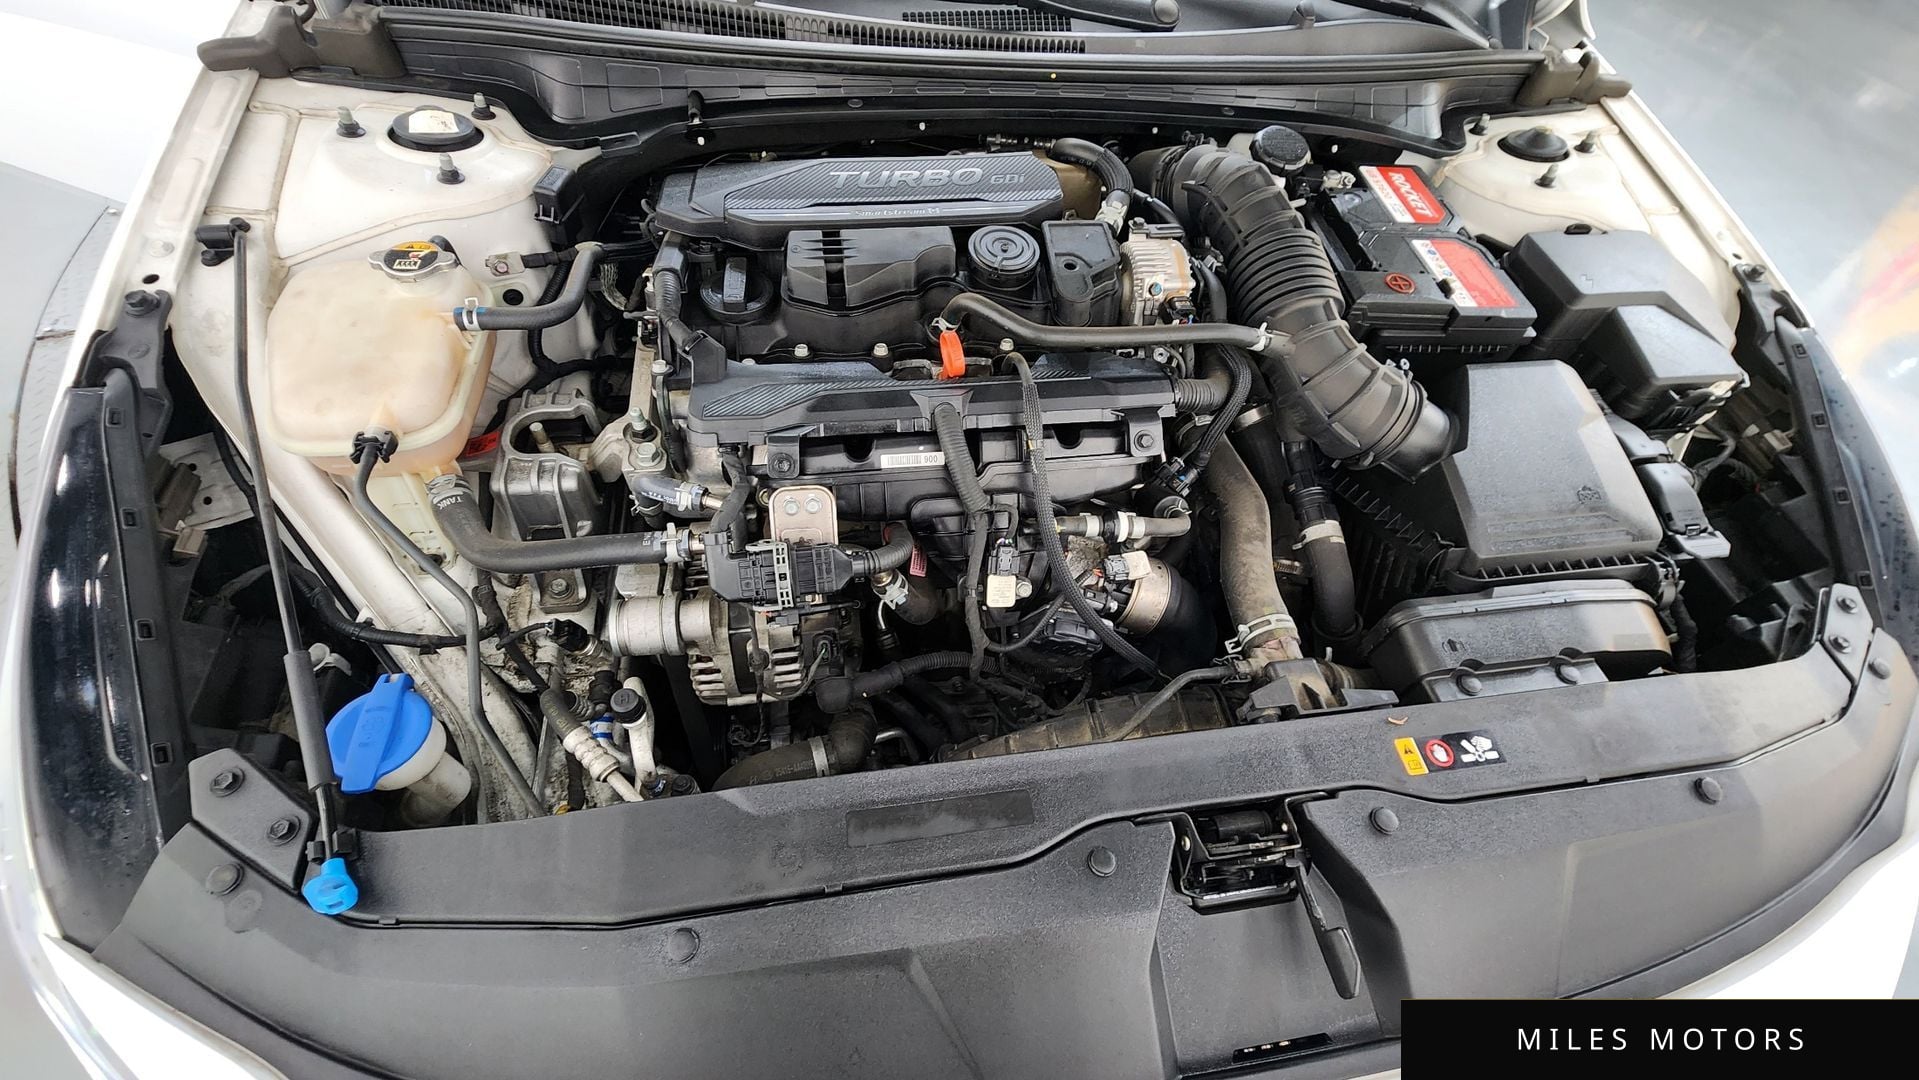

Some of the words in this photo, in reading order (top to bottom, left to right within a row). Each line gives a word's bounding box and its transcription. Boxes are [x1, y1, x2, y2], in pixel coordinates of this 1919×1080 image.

[829, 167, 984, 189] TURBO
[1388, 172, 1434, 218] ROCKET
[923, 454, 938, 464] 900
[436, 495, 463, 510] TANK
